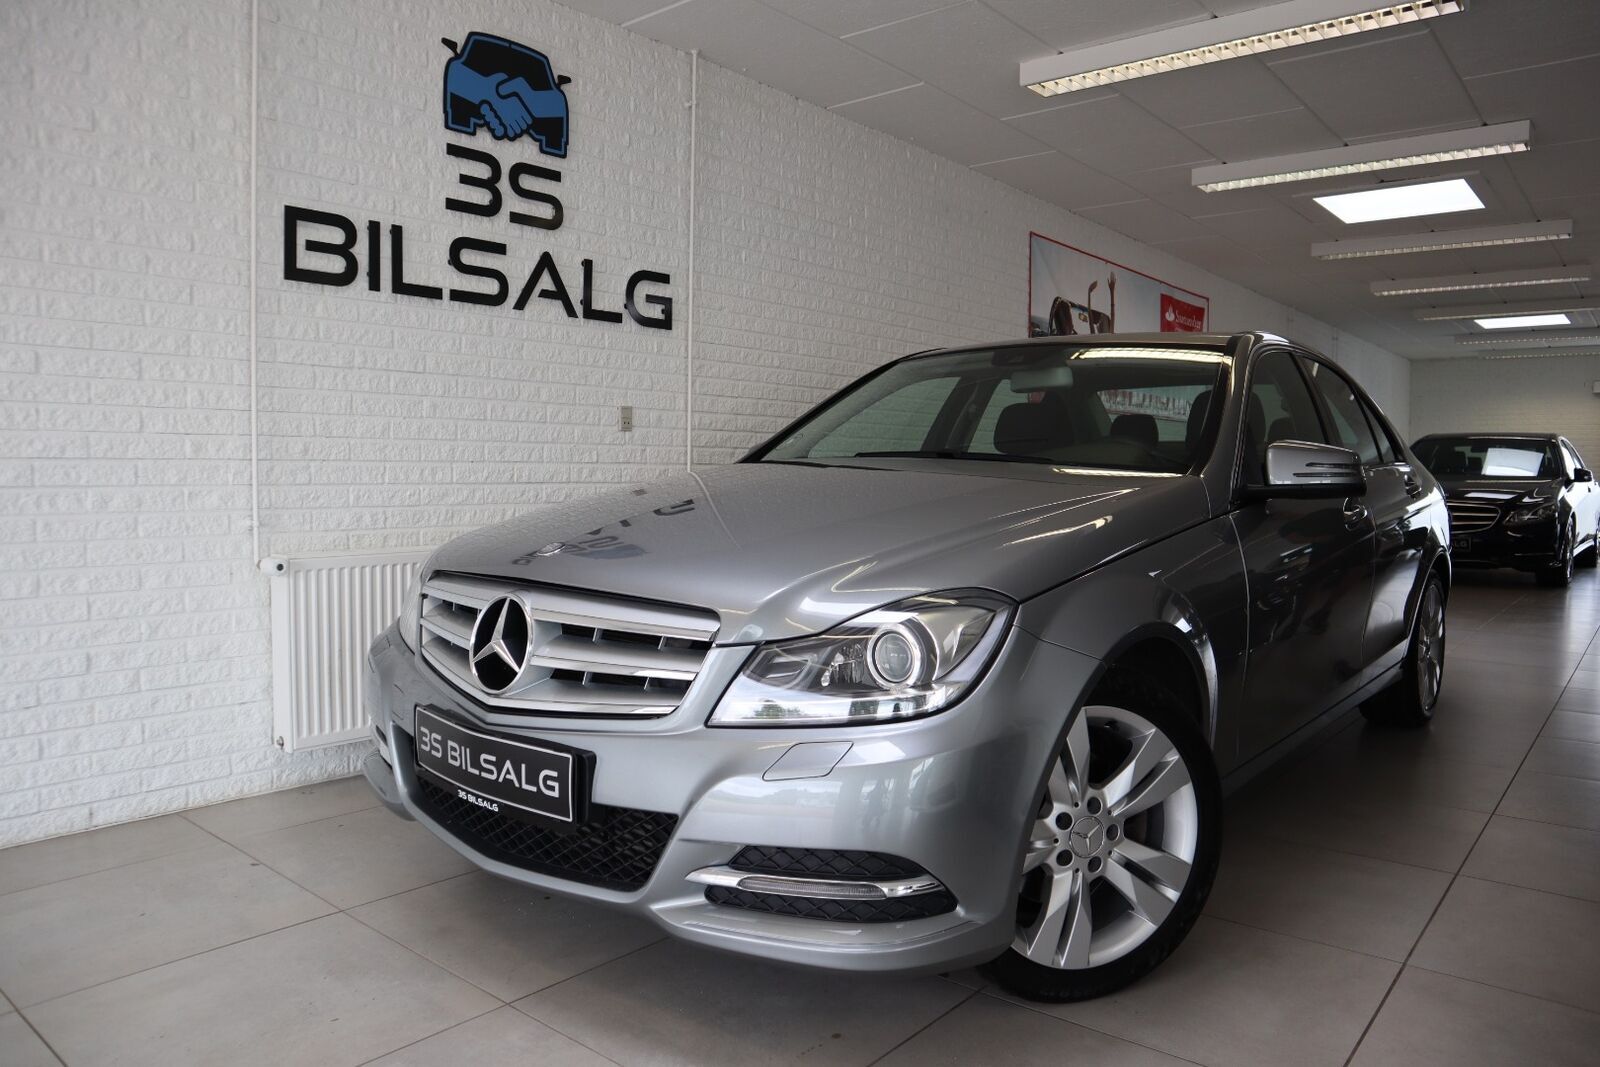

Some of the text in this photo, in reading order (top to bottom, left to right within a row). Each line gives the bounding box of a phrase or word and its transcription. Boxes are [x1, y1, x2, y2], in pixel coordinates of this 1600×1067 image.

[445, 143, 564, 231] 3S
[284, 205, 673, 331] BILSALG
[420, 726, 559, 798] 3S BILSALG
[457, 789, 499, 812] 3S BILSALG
